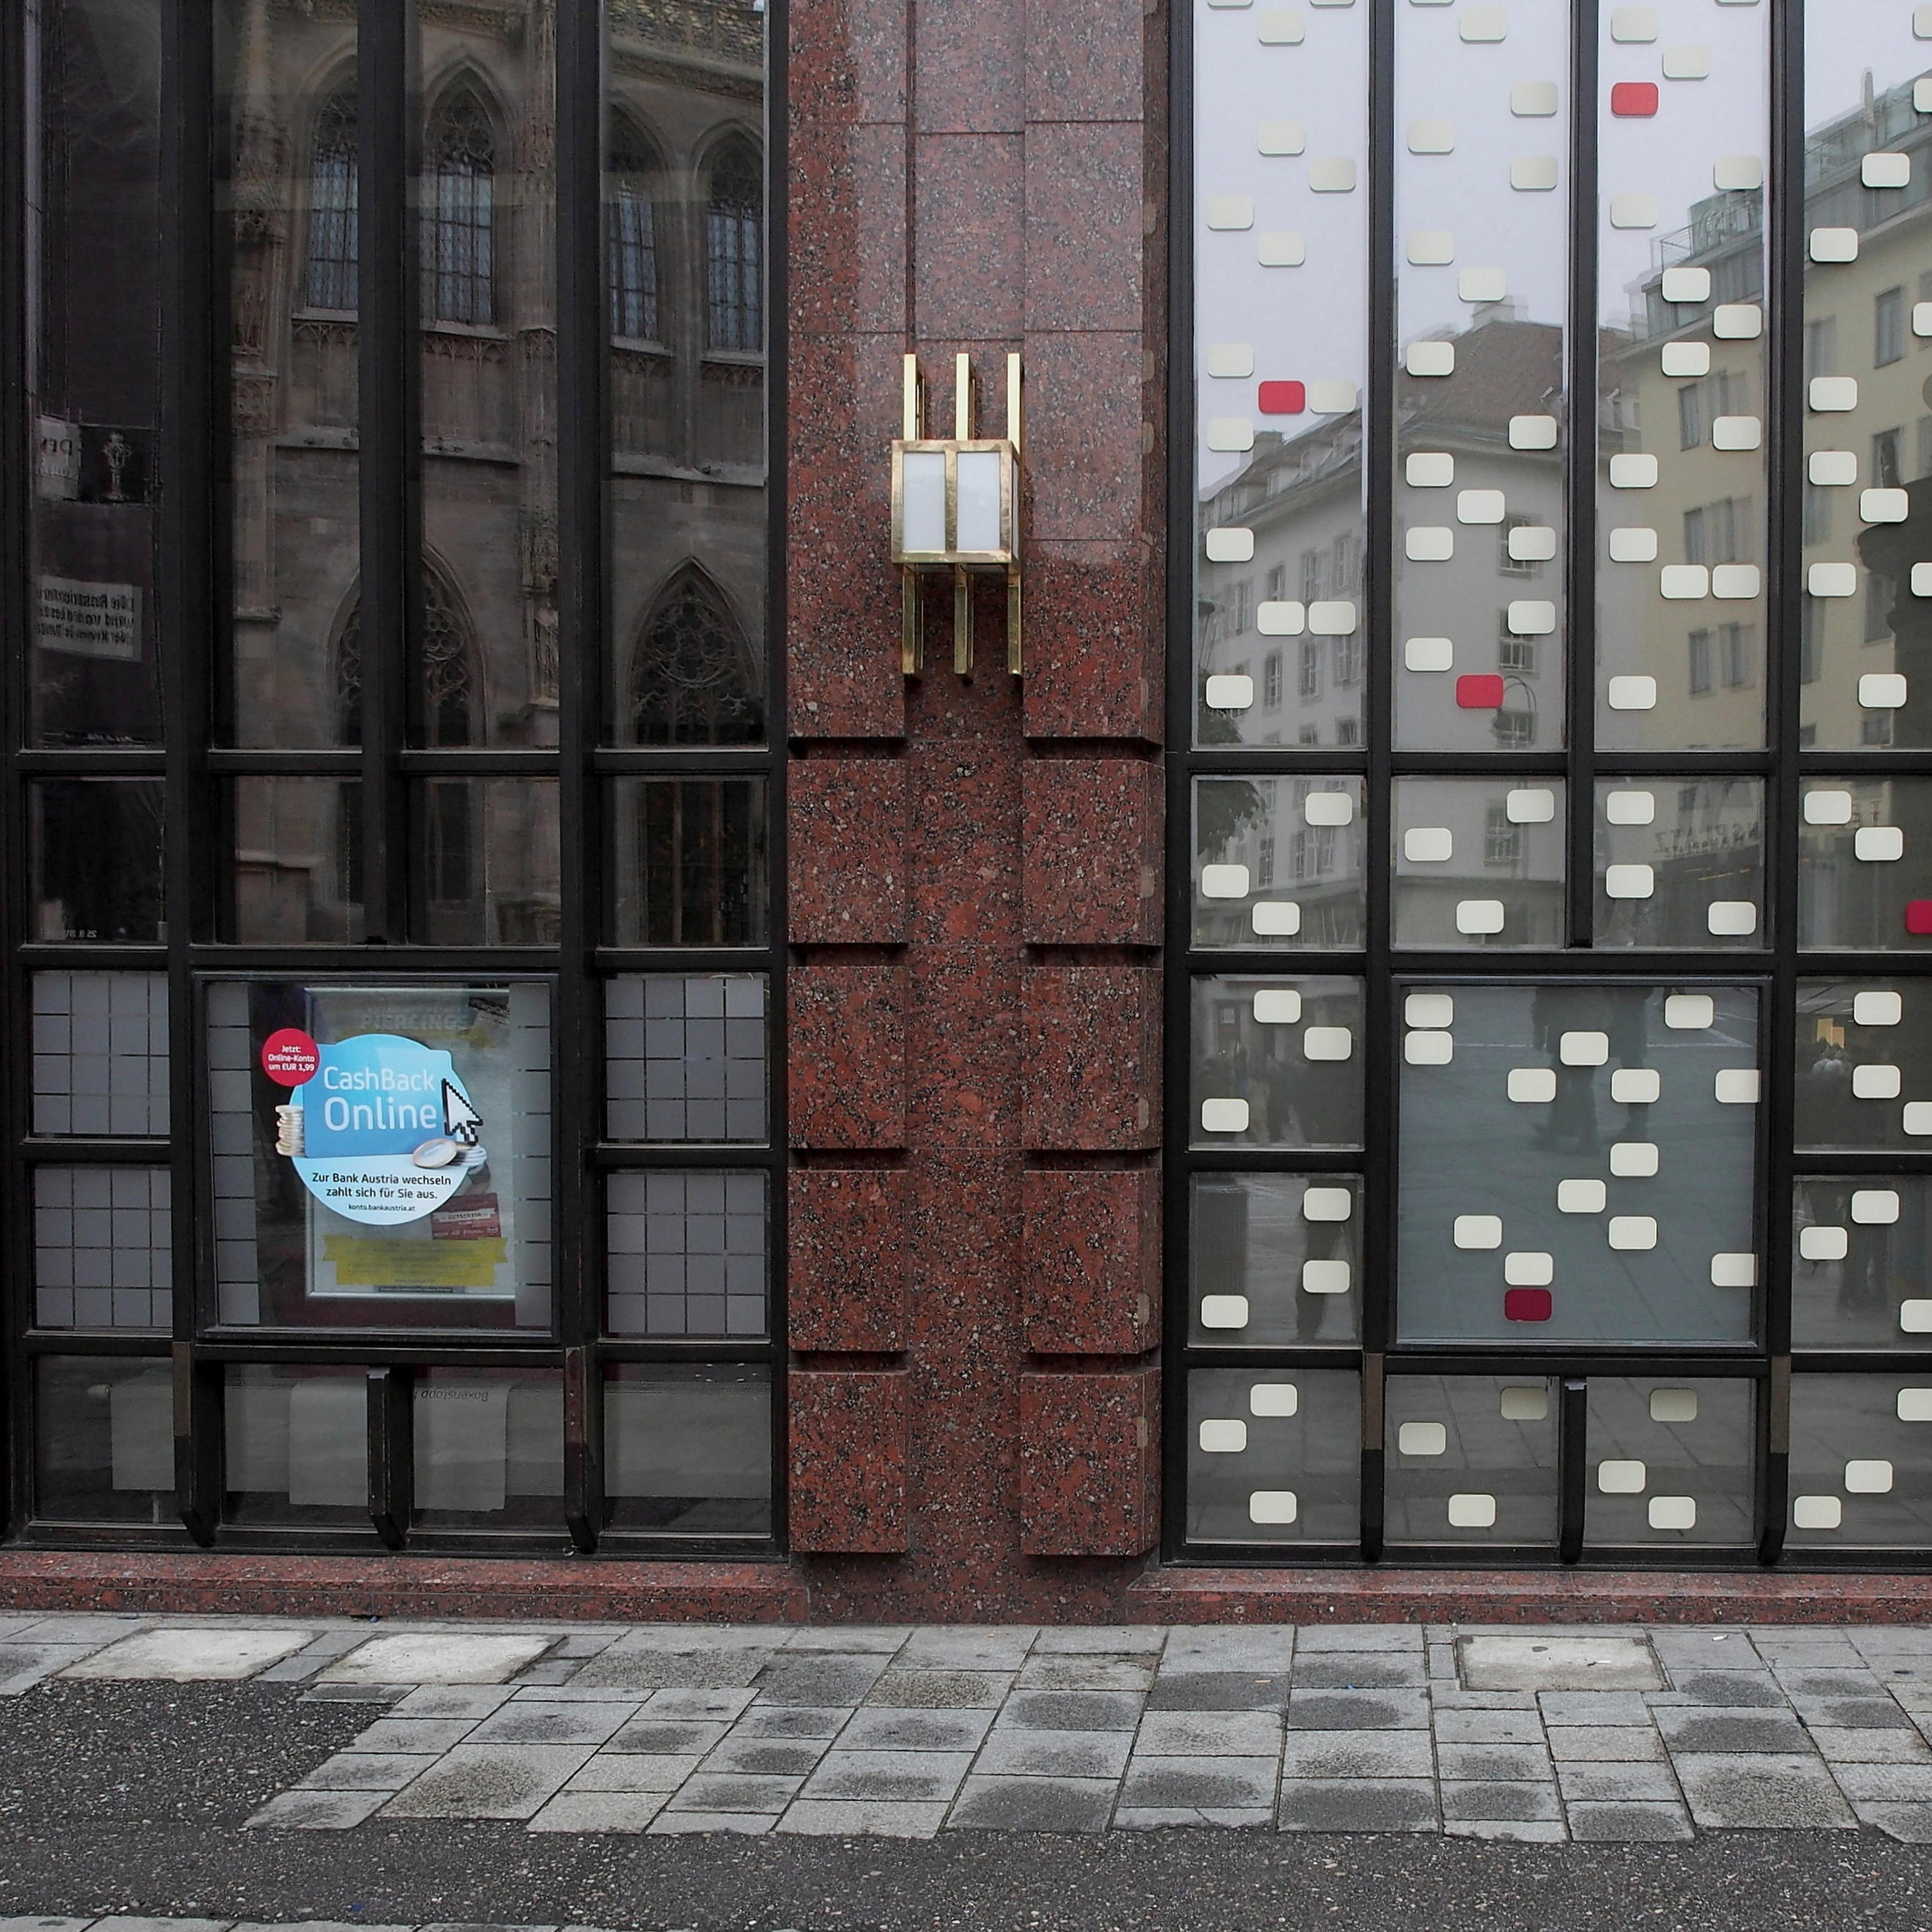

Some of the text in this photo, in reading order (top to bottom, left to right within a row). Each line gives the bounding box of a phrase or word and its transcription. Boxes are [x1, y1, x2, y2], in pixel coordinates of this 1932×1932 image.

[281, 1045, 301, 1054] Jetzt:
[268, 1054, 315, 1063] Online-Konto
[282, 1062, 297, 1071] EUR
[298, 1062, 315, 1072] 1,99
[323, 1066, 435, 1092] CashBack
[324, 1096, 437, 1132] Online
[311, 1172, 451, 1185] Zur Bank Austria wechseln
[326, 1187, 438, 1199] zahlt sich für Sie aus.
[348, 1203, 416, 1213] konto.bankaustria.at
